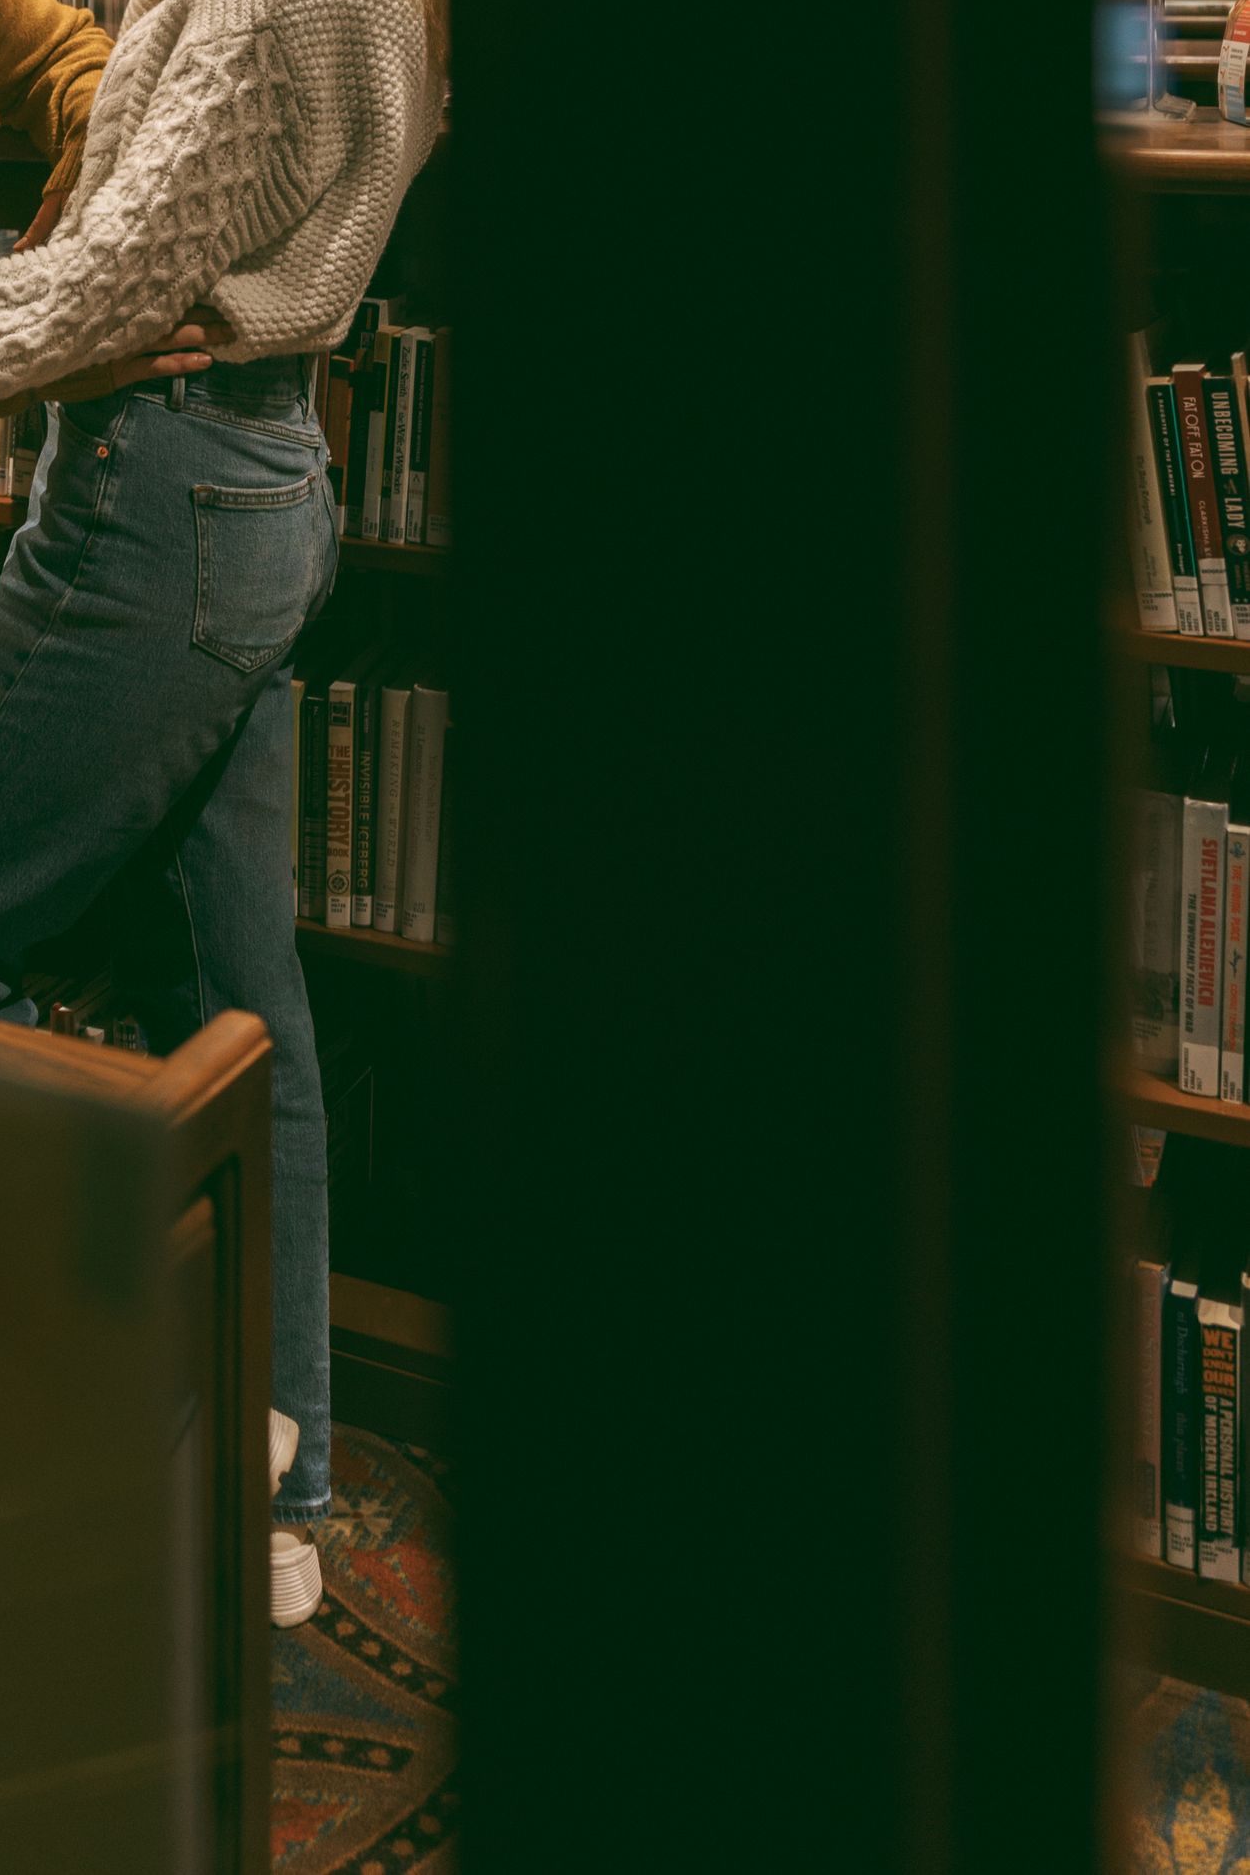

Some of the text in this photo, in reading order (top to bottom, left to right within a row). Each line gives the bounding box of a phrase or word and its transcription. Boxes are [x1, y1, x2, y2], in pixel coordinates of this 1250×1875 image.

[399, 346, 411, 397] Zadie Smith
[1158, 399, 1169, 435] DAUGHTER
[1182, 397, 1198, 412] FAT
[393, 412, 406, 494] the Wife of Willesden
[1163, 438, 1170, 446] OF
[1164, 449, 1172, 463] THE
[1188, 442, 1203, 458] FAT
[1210, 391, 1245, 529] UNBECOMING LADY
[1166, 464, 1176, 497] SAMURAI
[1190, 460, 1206, 478] ON
[1198, 500, 1211, 545] CLARKISHA
[417, 725, 425, 736] 21
[329, 745, 351, 758] THE
[389, 719, 400, 798] REMAKING
[415, 738, 424, 775] Lessons
[327, 759, 350, 846] HISTORY
[357, 750, 372, 889] INVISIBLE ICEBERG
[326, 847, 349, 858] BOOK
[387, 819, 397, 868] WORLD
[1197, 838, 1218, 1006] SVETLANA ALEXIEVICH
[1230, 864, 1242, 942] THE HIDING PLACE
[1184, 893, 1197, 1033] THE UNWOMANLY FACE OF WAR
[1202, 1330, 1235, 1347] WE
[1202, 1371, 1235, 1387] OUR
[1204, 1395, 1218, 1532] OF MODERN IRELAND
[1219, 1396, 1234, 1535] A PERSONAL HISTORY
